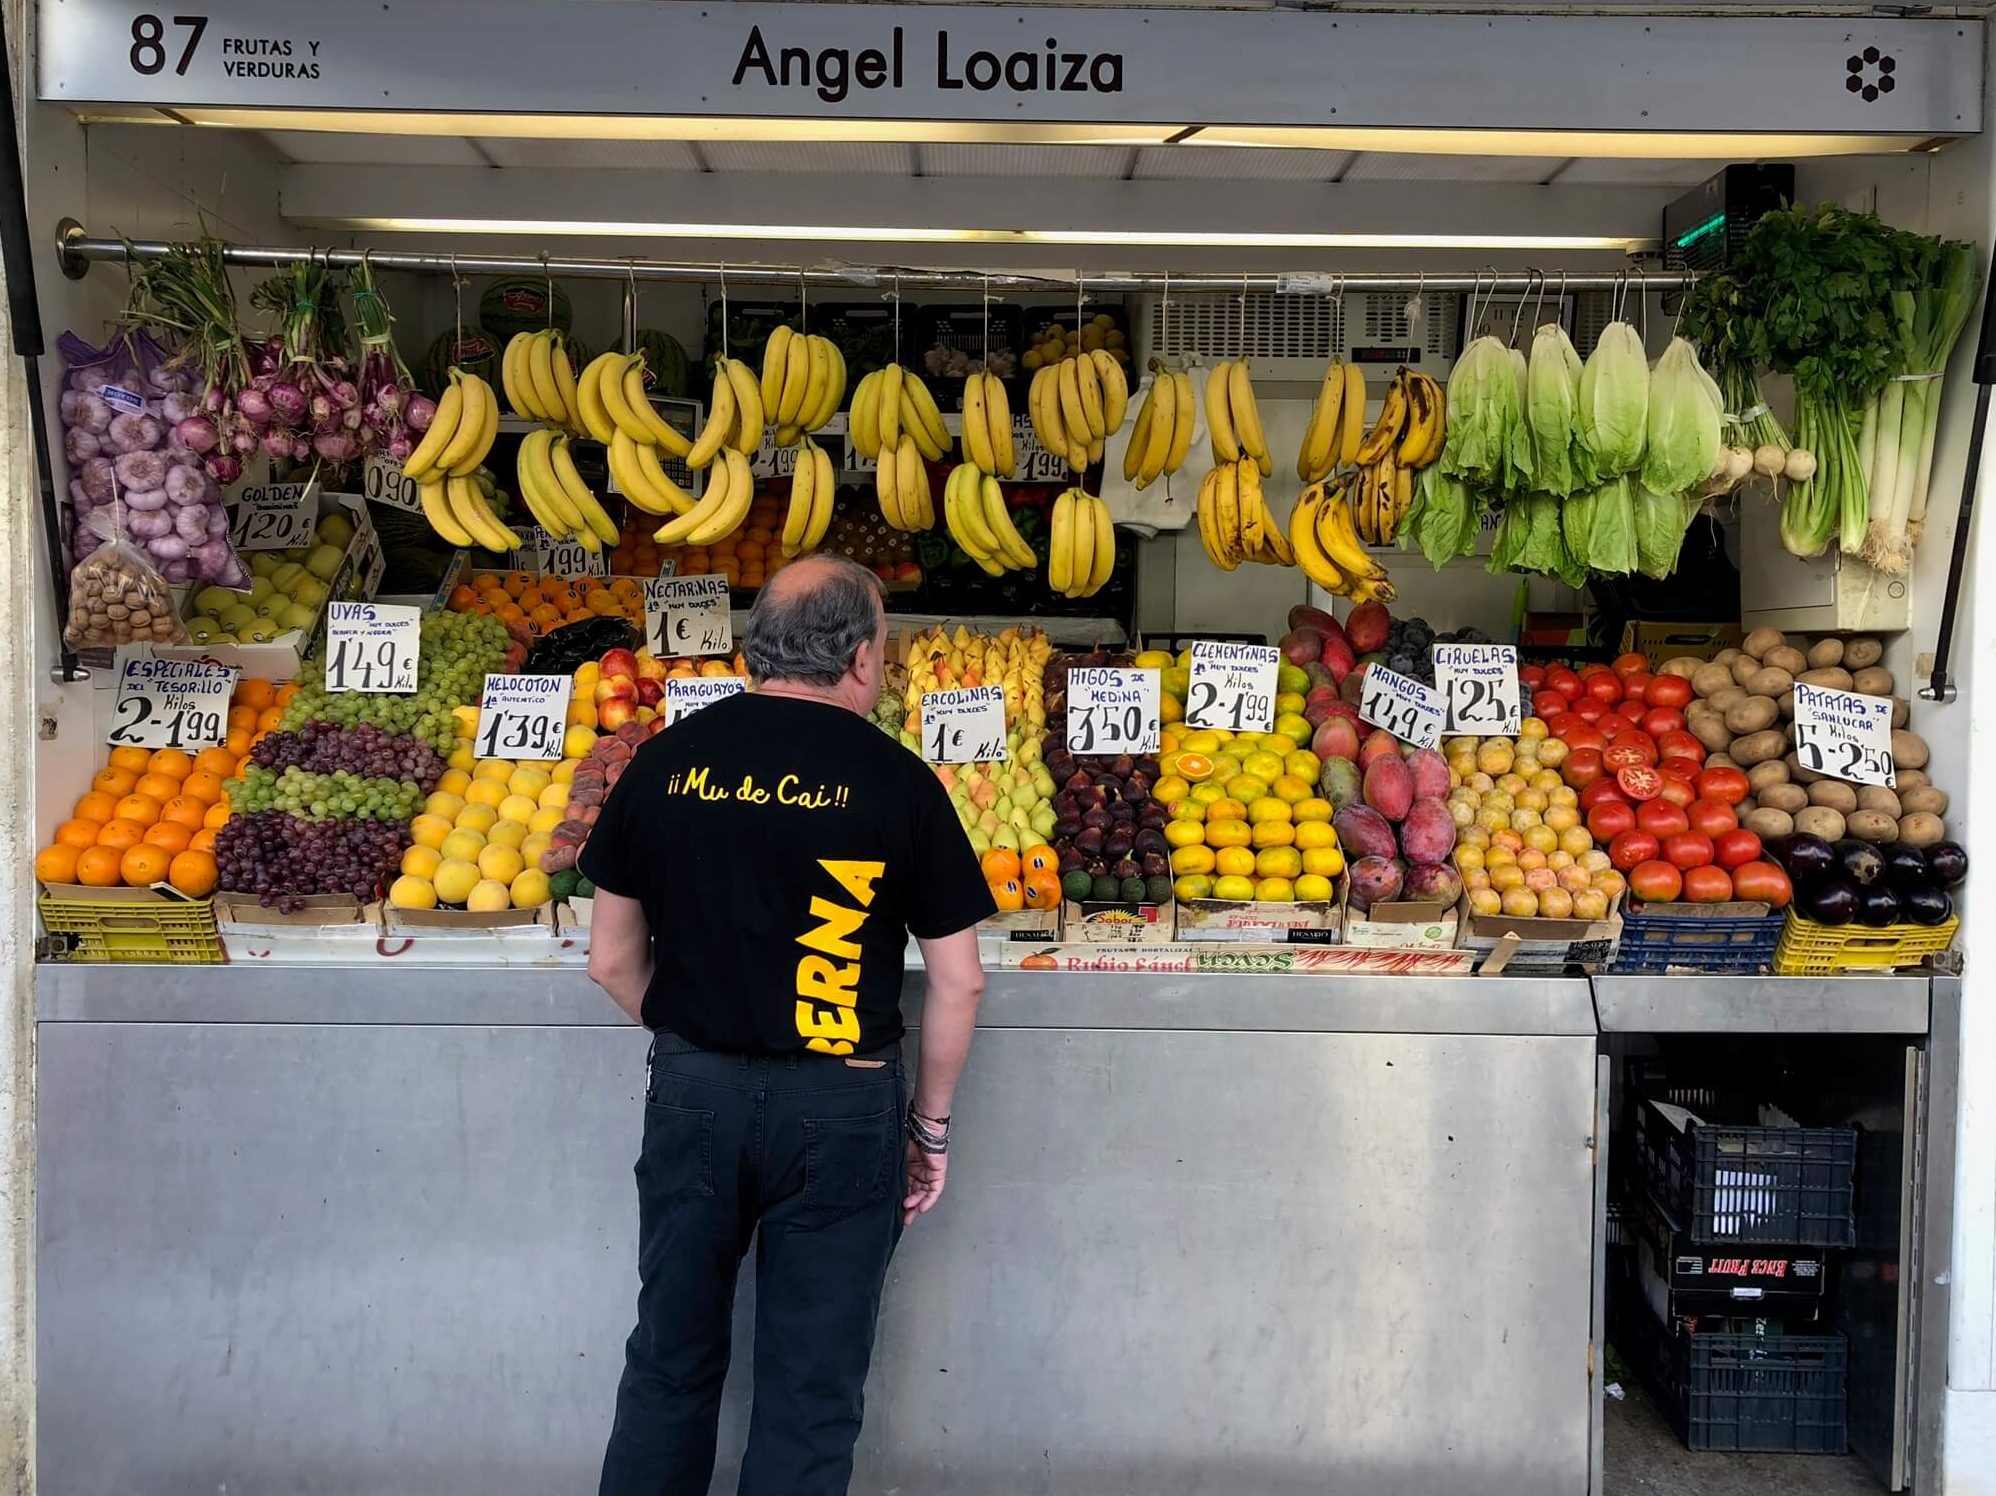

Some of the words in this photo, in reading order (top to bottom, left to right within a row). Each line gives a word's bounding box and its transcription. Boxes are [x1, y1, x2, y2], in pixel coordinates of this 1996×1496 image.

[129, 13, 209, 77] 87
[222, 38, 293, 57] FRUTAS
[307, 40, 321, 57] Y
[222, 60, 321, 80] VERDURAS
[731, 24, 903, 103] Angel
[937, 30, 1123, 93] Loaiza
[241, 485, 304, 502] GOLDEN
[331, 603, 377, 621] UVAS
[653, 611, 680, 657] 1
[675, 617, 691, 640] €
[700, 625, 728, 651] Kilo
[327, 637, 396, 689] 1'49
[402, 657, 414, 671] €
[1191, 642, 1279, 664] CLEMENTINAS
[1435, 647, 1516, 665] CIRUELAS
[1069, 668, 1123, 688] HIGOS
[1370, 664, 1428, 702] MANGOS
[163, 693, 196, 710] Kilos
[921, 685, 1003, 707] ERCOLINAS
[1441, 676, 1507, 733] 1'25
[1794, 684, 1867, 715] PATATAS
[480, 709, 549, 757] 1'39
[930, 723, 953, 762] 1
[952, 729, 965, 747] €
[735, 774, 771, 805] de
